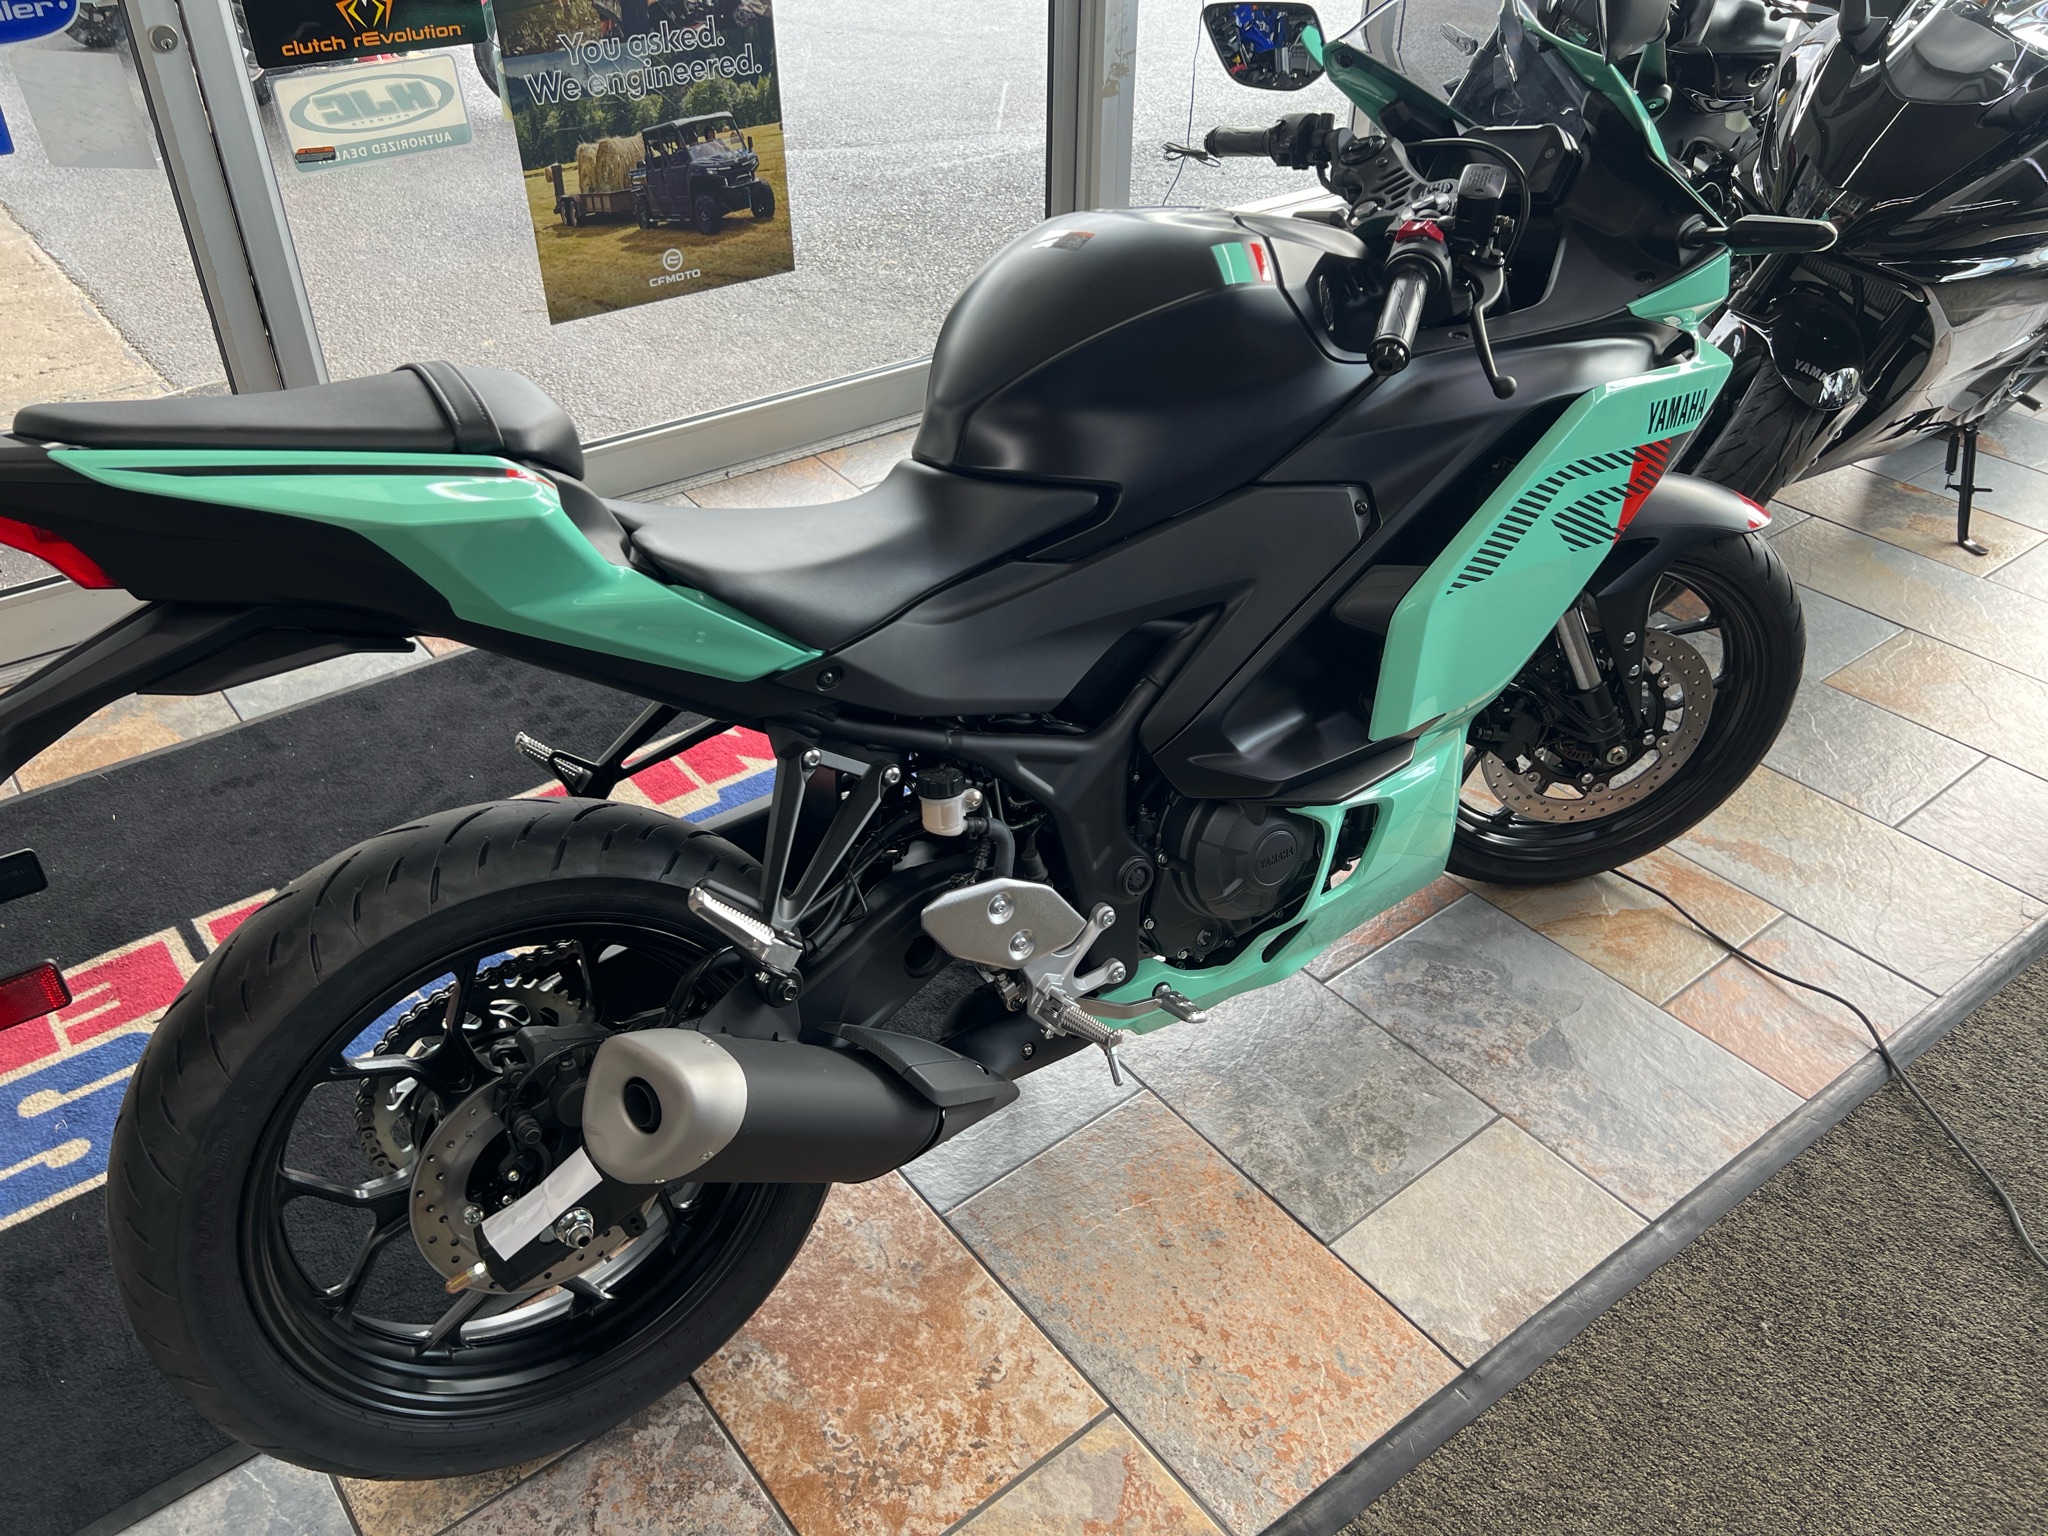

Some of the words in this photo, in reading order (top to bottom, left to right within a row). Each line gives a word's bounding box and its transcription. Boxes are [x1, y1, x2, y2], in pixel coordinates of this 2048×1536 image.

[0, 0, 53, 21] ler
[281, 35, 346, 57] clutch
[353, 24, 462, 48] rEvolution
[558, 31, 620, 65] You
[627, 14, 725, 58] asked.
[524, 69, 582, 106] We
[587, 42, 762, 100] engineered.
[649, 268, 701, 287] CFMOTO
[1647, 388, 1708, 435] YAMAHA
[1260, 847, 1294, 868] YAMAHA
